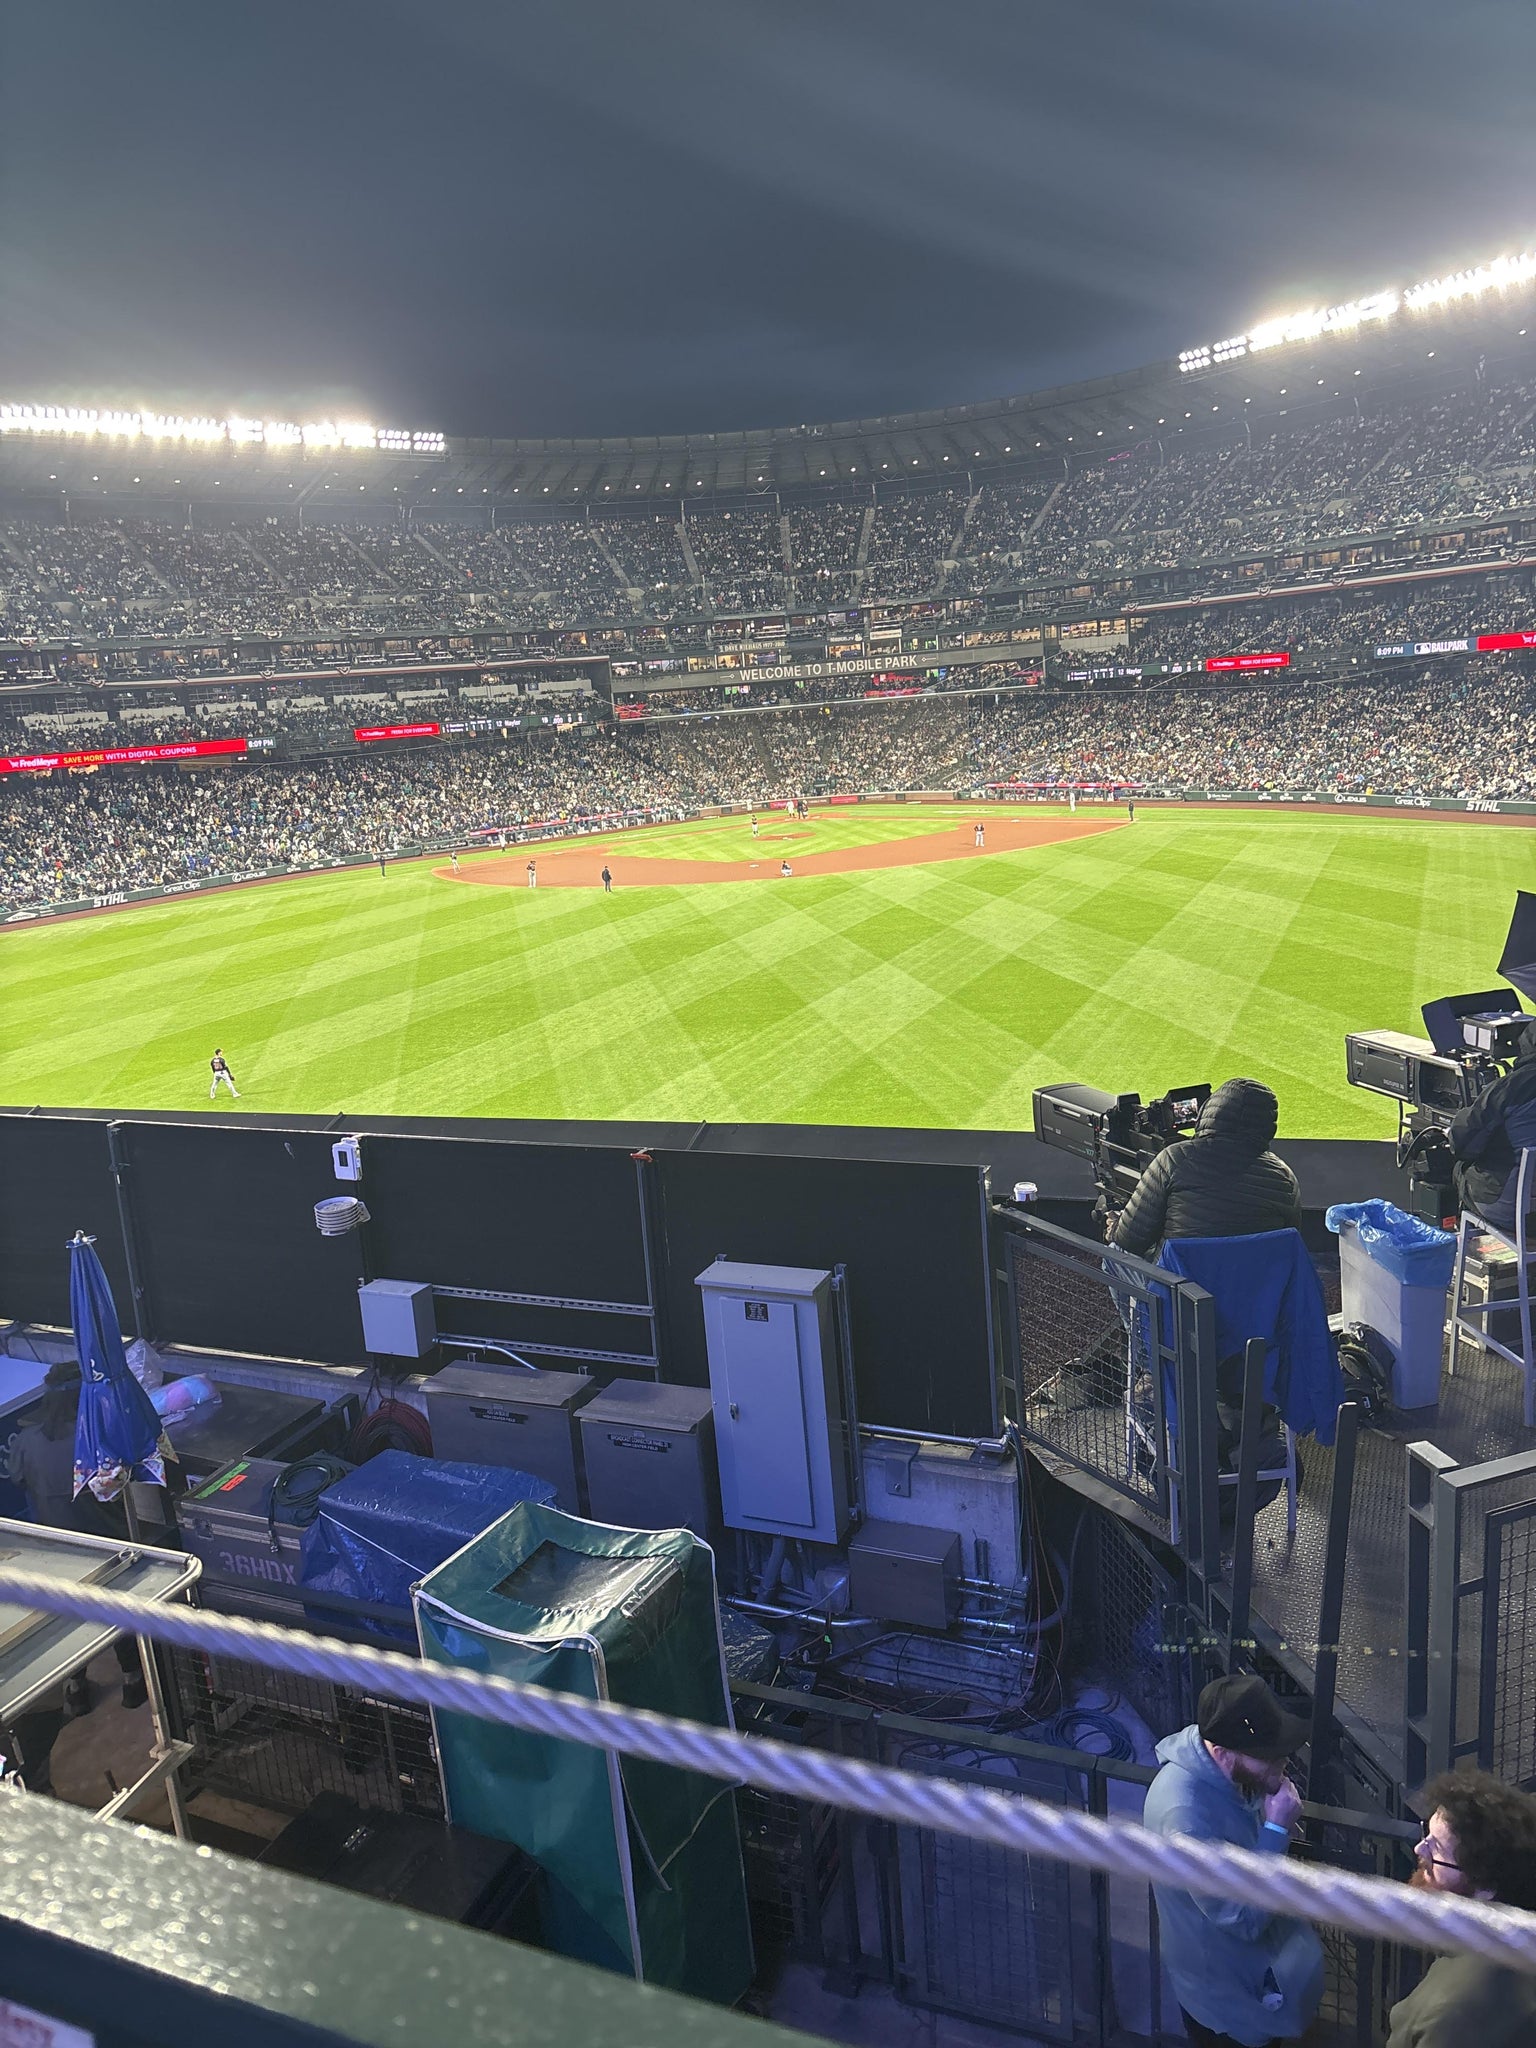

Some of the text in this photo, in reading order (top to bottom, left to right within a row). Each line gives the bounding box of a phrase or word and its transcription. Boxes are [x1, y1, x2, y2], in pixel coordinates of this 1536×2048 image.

[1377, 646, 1404, 656] 8:09 PM
[1431, 640, 1469, 653] BALLPARK
[740, 655, 918, 681] WELCOME TO T-MOBILE PARK
[504, 719, 521, 727] Naylor
[248, 738, 274, 748] 8:09 PM
[63, 756, 82, 764] SAVE
[84, 754, 104, 762] MORE
[105, 752, 126, 760] WITH
[128, 750, 158, 758] DIGITAL
[160, 746, 197, 755] COUPONS
[1395, 796, 1431, 809] Great Clips
[1465, 800, 1501, 812] STIHL
[241, 871, 267, 880] LEXUS
[163, 880, 200, 893] Great Clips
[93, 892, 128, 908] STIHL
[1356, 1067, 1362, 1077] 2
[219, 1551, 297, 1586] 36HDX
